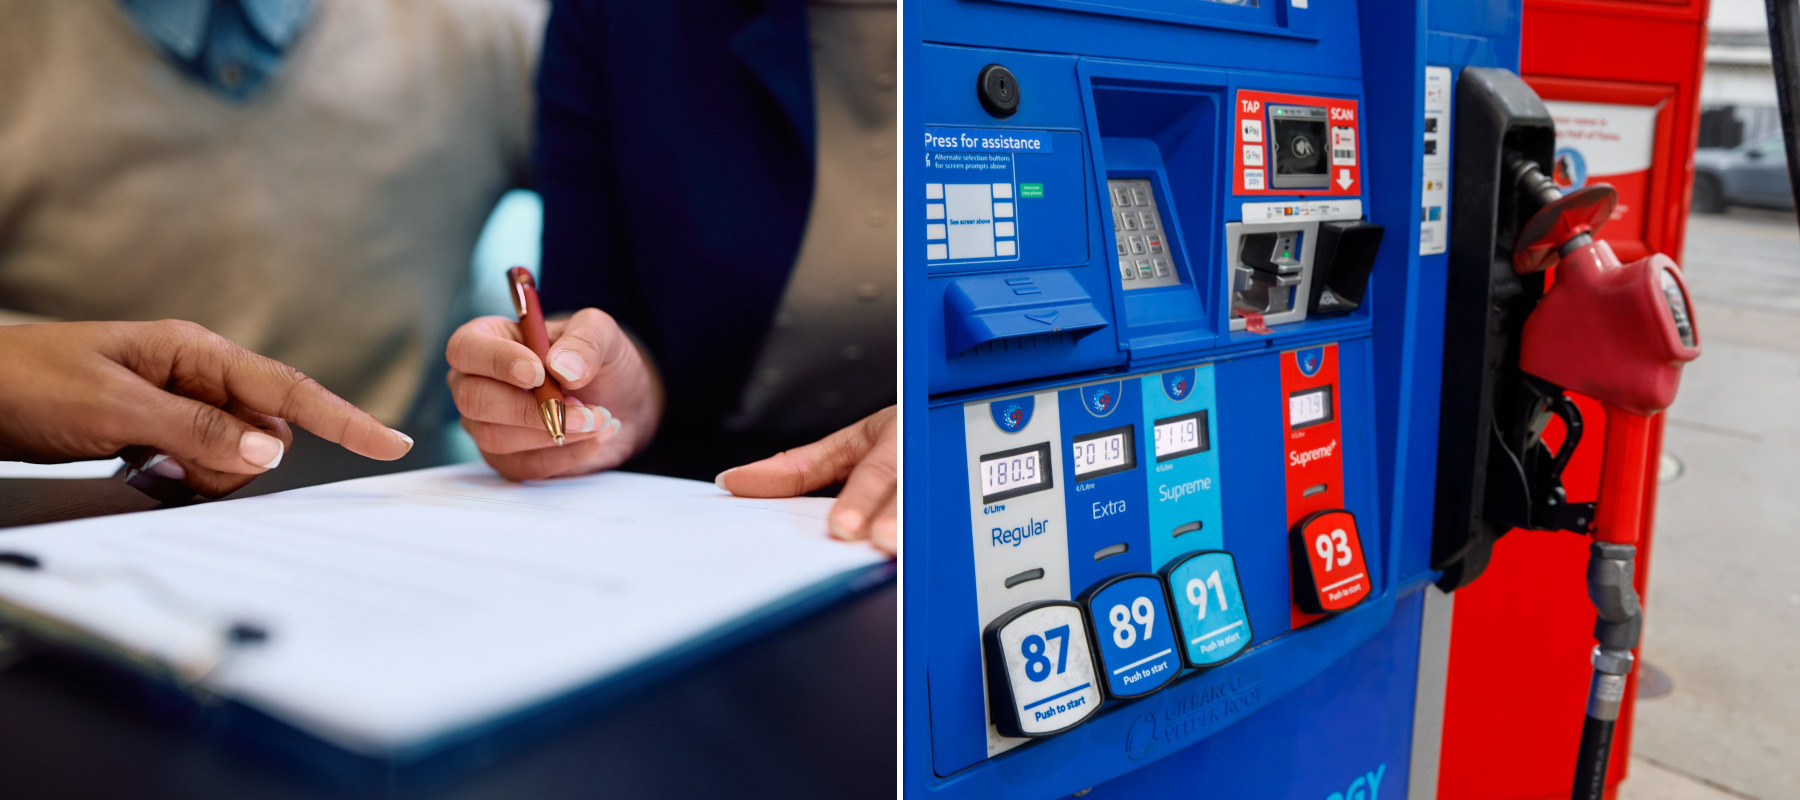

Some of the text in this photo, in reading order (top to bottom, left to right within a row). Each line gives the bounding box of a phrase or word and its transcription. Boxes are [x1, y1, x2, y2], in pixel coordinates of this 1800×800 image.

[1241, 99, 1260, 114] TAP
[1330, 107, 1354, 121] SCAN
[924, 132, 1041, 150] Press for assistance
[1249, 126, 1260, 137] Pay
[934, 153, 1011, 163] Alternate selection buttons
[934, 161, 944, 169] for
[965, 162, 989, 172] prompts
[989, 161, 1007, 170] above
[949, 218, 960, 226] See
[1074, 437, 1120, 468] 201.9
[989, 455, 1035, 487] 180.9
[1158, 477, 1212, 503] Supreme
[1092, 499, 1126, 520] Extra
[991, 517, 1048, 547] Regular
[1315, 528, 1352, 572] 93
[1186, 569, 1228, 621] 91
[1328, 589, 1343, 602] Push
[1349, 583, 1362, 594] start
[1109, 596, 1155, 649] 89
[1021, 623, 1070, 683] 87
[1200, 632, 1240, 654] Push to start
[1123, 660, 1168, 685] Push to start
[1035, 695, 1086, 722] Push to start
[1325, 762, 1387, 800] GY
